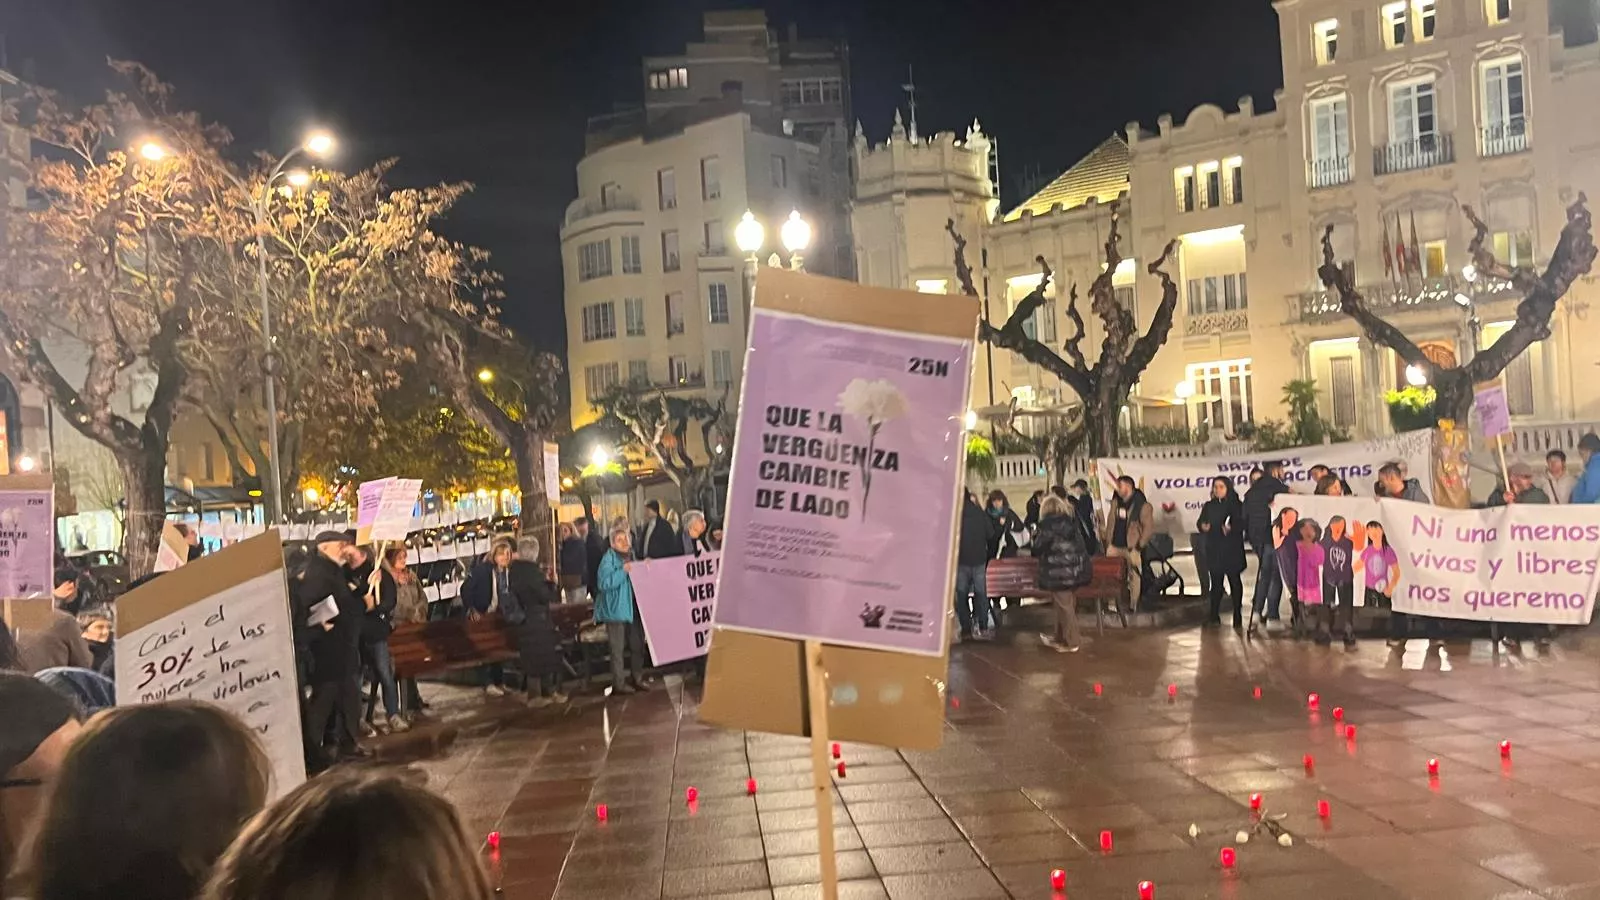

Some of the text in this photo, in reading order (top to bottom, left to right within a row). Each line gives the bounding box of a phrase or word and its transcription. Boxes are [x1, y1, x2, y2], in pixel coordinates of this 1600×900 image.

[908, 357, 949, 378] 25N
[766, 405, 843, 433] QUE LA
[763, 433, 899, 472] VERGÜENZA
[759, 460, 850, 490] CAMBIE
[755, 488, 849, 519] DE LADO
[1411, 514, 1600, 543] Ni una menos
[686, 559, 714, 580] QUE
[1409, 549, 1598, 580] vivas y libres
[1408, 583, 1451, 603] nos
[139, 604, 225, 657] Casi el
[137, 623, 266, 690] 30% de las
[141, 656, 249, 702] mujeres ha
